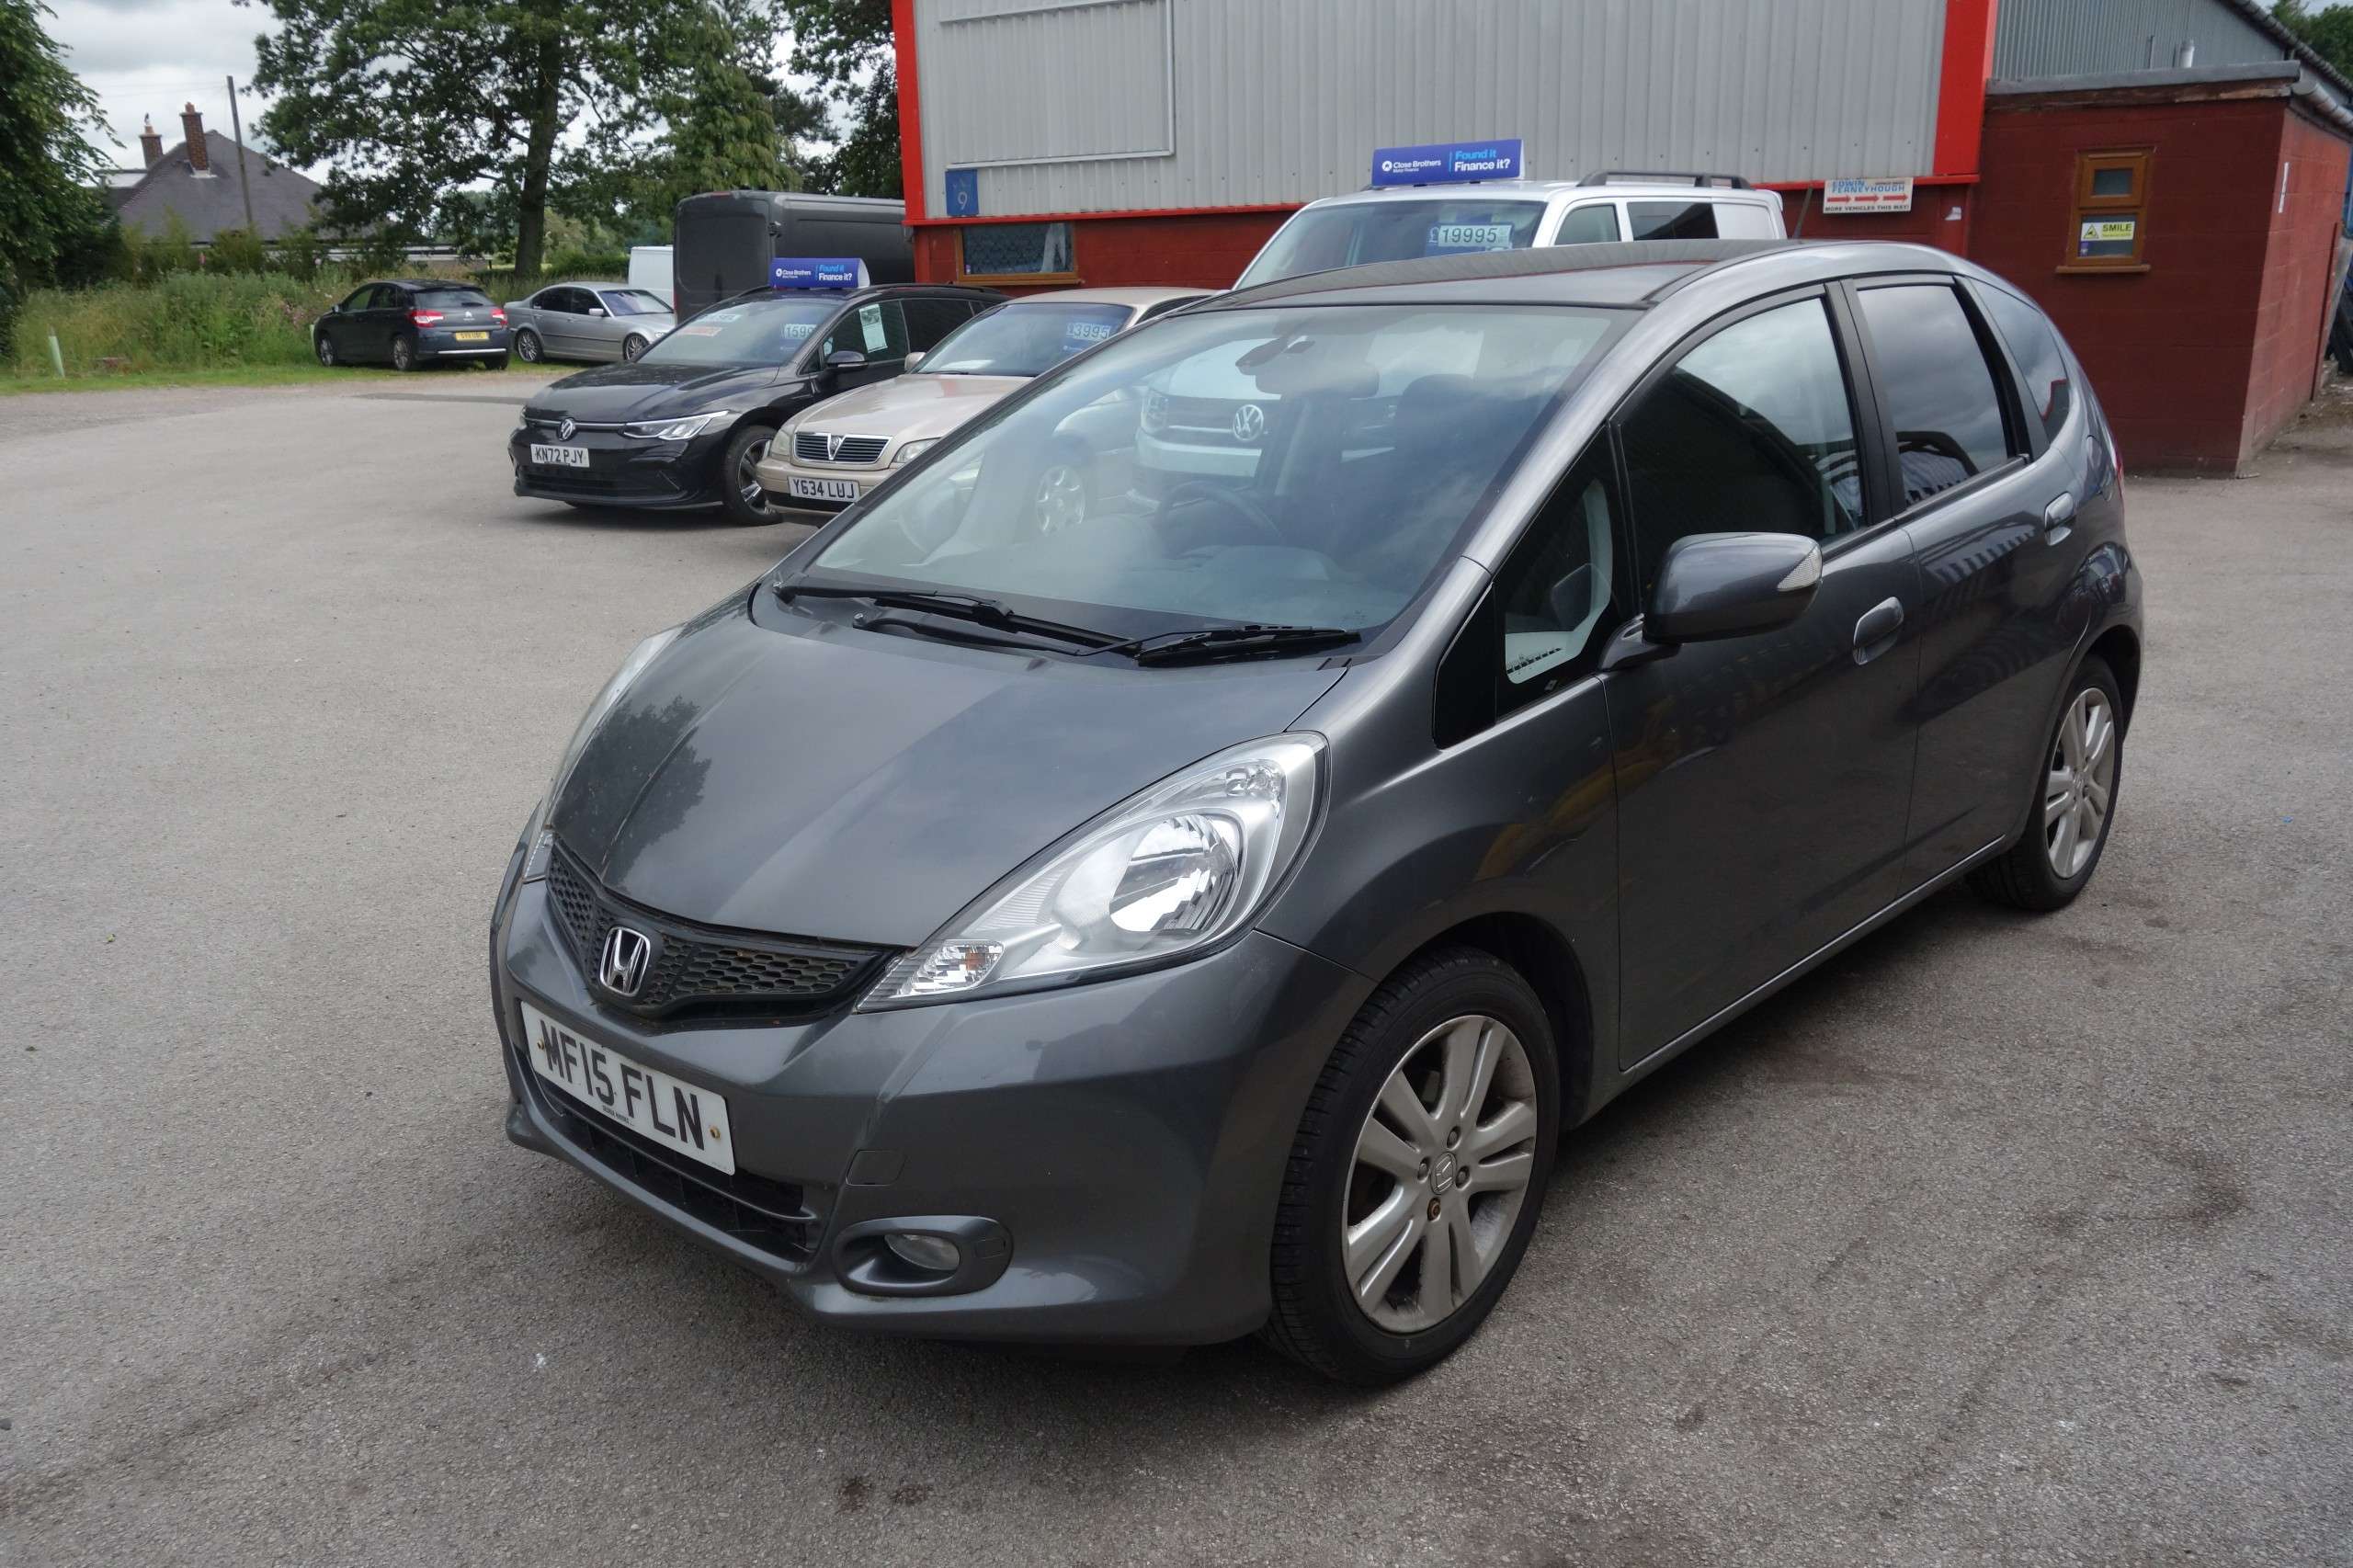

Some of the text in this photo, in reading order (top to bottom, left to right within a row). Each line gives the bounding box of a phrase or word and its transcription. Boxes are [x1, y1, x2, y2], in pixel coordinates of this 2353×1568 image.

[1455, 149, 1496, 160] Found it
[1413, 160, 1441, 168] Brothers
[1454, 159, 1511, 172] Finance it?
[958, 191, 968, 210] 9
[2102, 223, 2132, 232] SMILE
[819, 272, 853, 281] Finance it?
[535, 447, 584, 464] KN72 PJY
[793, 479, 855, 498] Y634 LUJ
[540, 1019, 705, 1151] MF15 FLN
